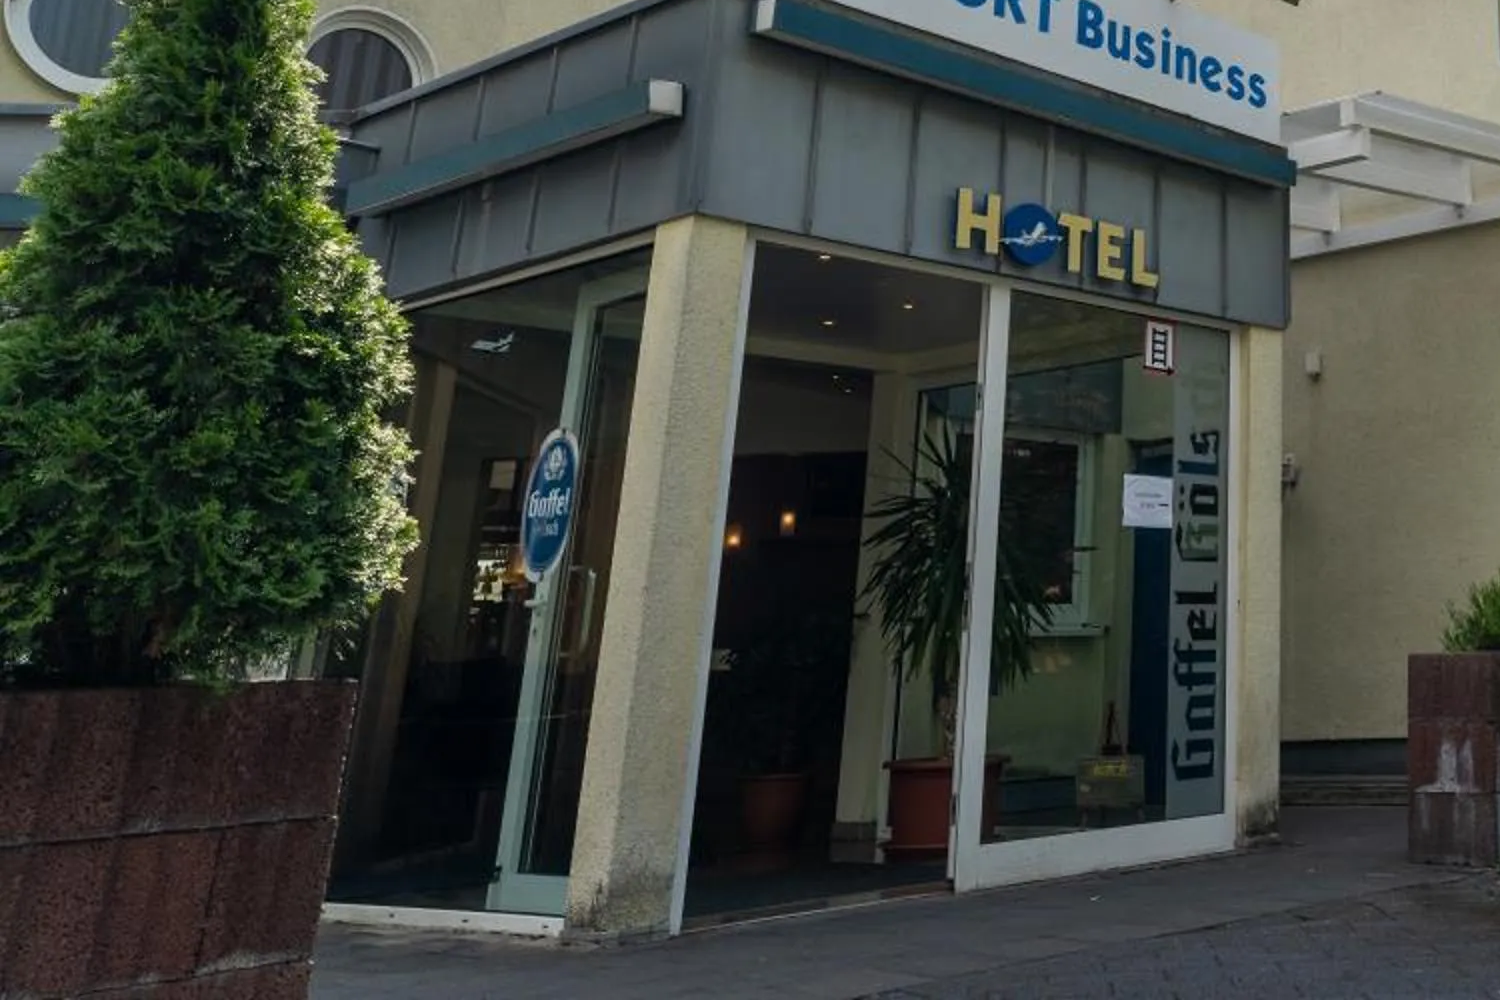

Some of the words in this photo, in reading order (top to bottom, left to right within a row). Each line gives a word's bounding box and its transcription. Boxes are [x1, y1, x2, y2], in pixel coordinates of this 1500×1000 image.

[953, 187, 1159, 289] HOTEL
[527, 487, 571, 519] Gaffel
[1171, 581, 1218, 781] Gaffel
